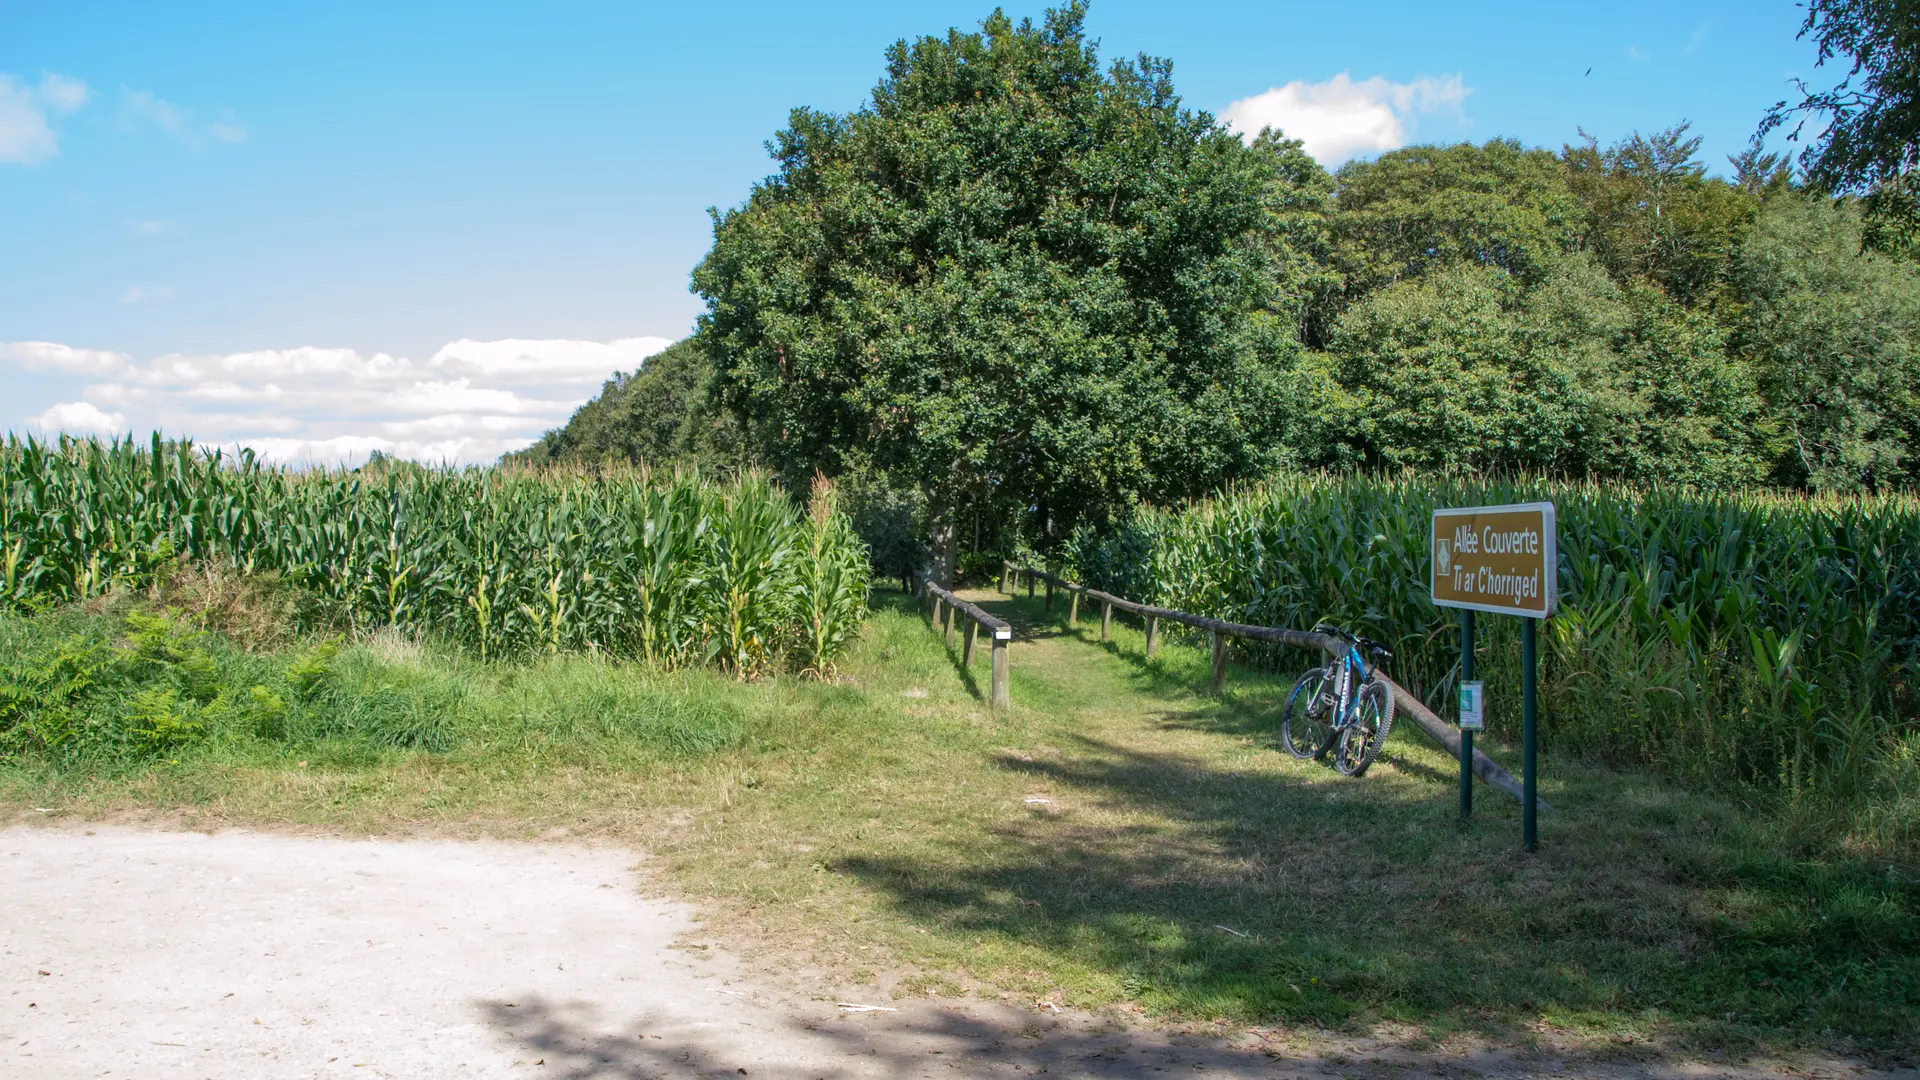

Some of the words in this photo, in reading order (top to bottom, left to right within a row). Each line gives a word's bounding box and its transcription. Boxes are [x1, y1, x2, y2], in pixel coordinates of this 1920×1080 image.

[1453, 524, 1479, 553] Allée
[1483, 525, 1538, 555] Couverte
[1453, 564, 1462, 591] Ti
[1464, 572, 1475, 592] ar
[1478, 565, 1538, 605] C'horriged
